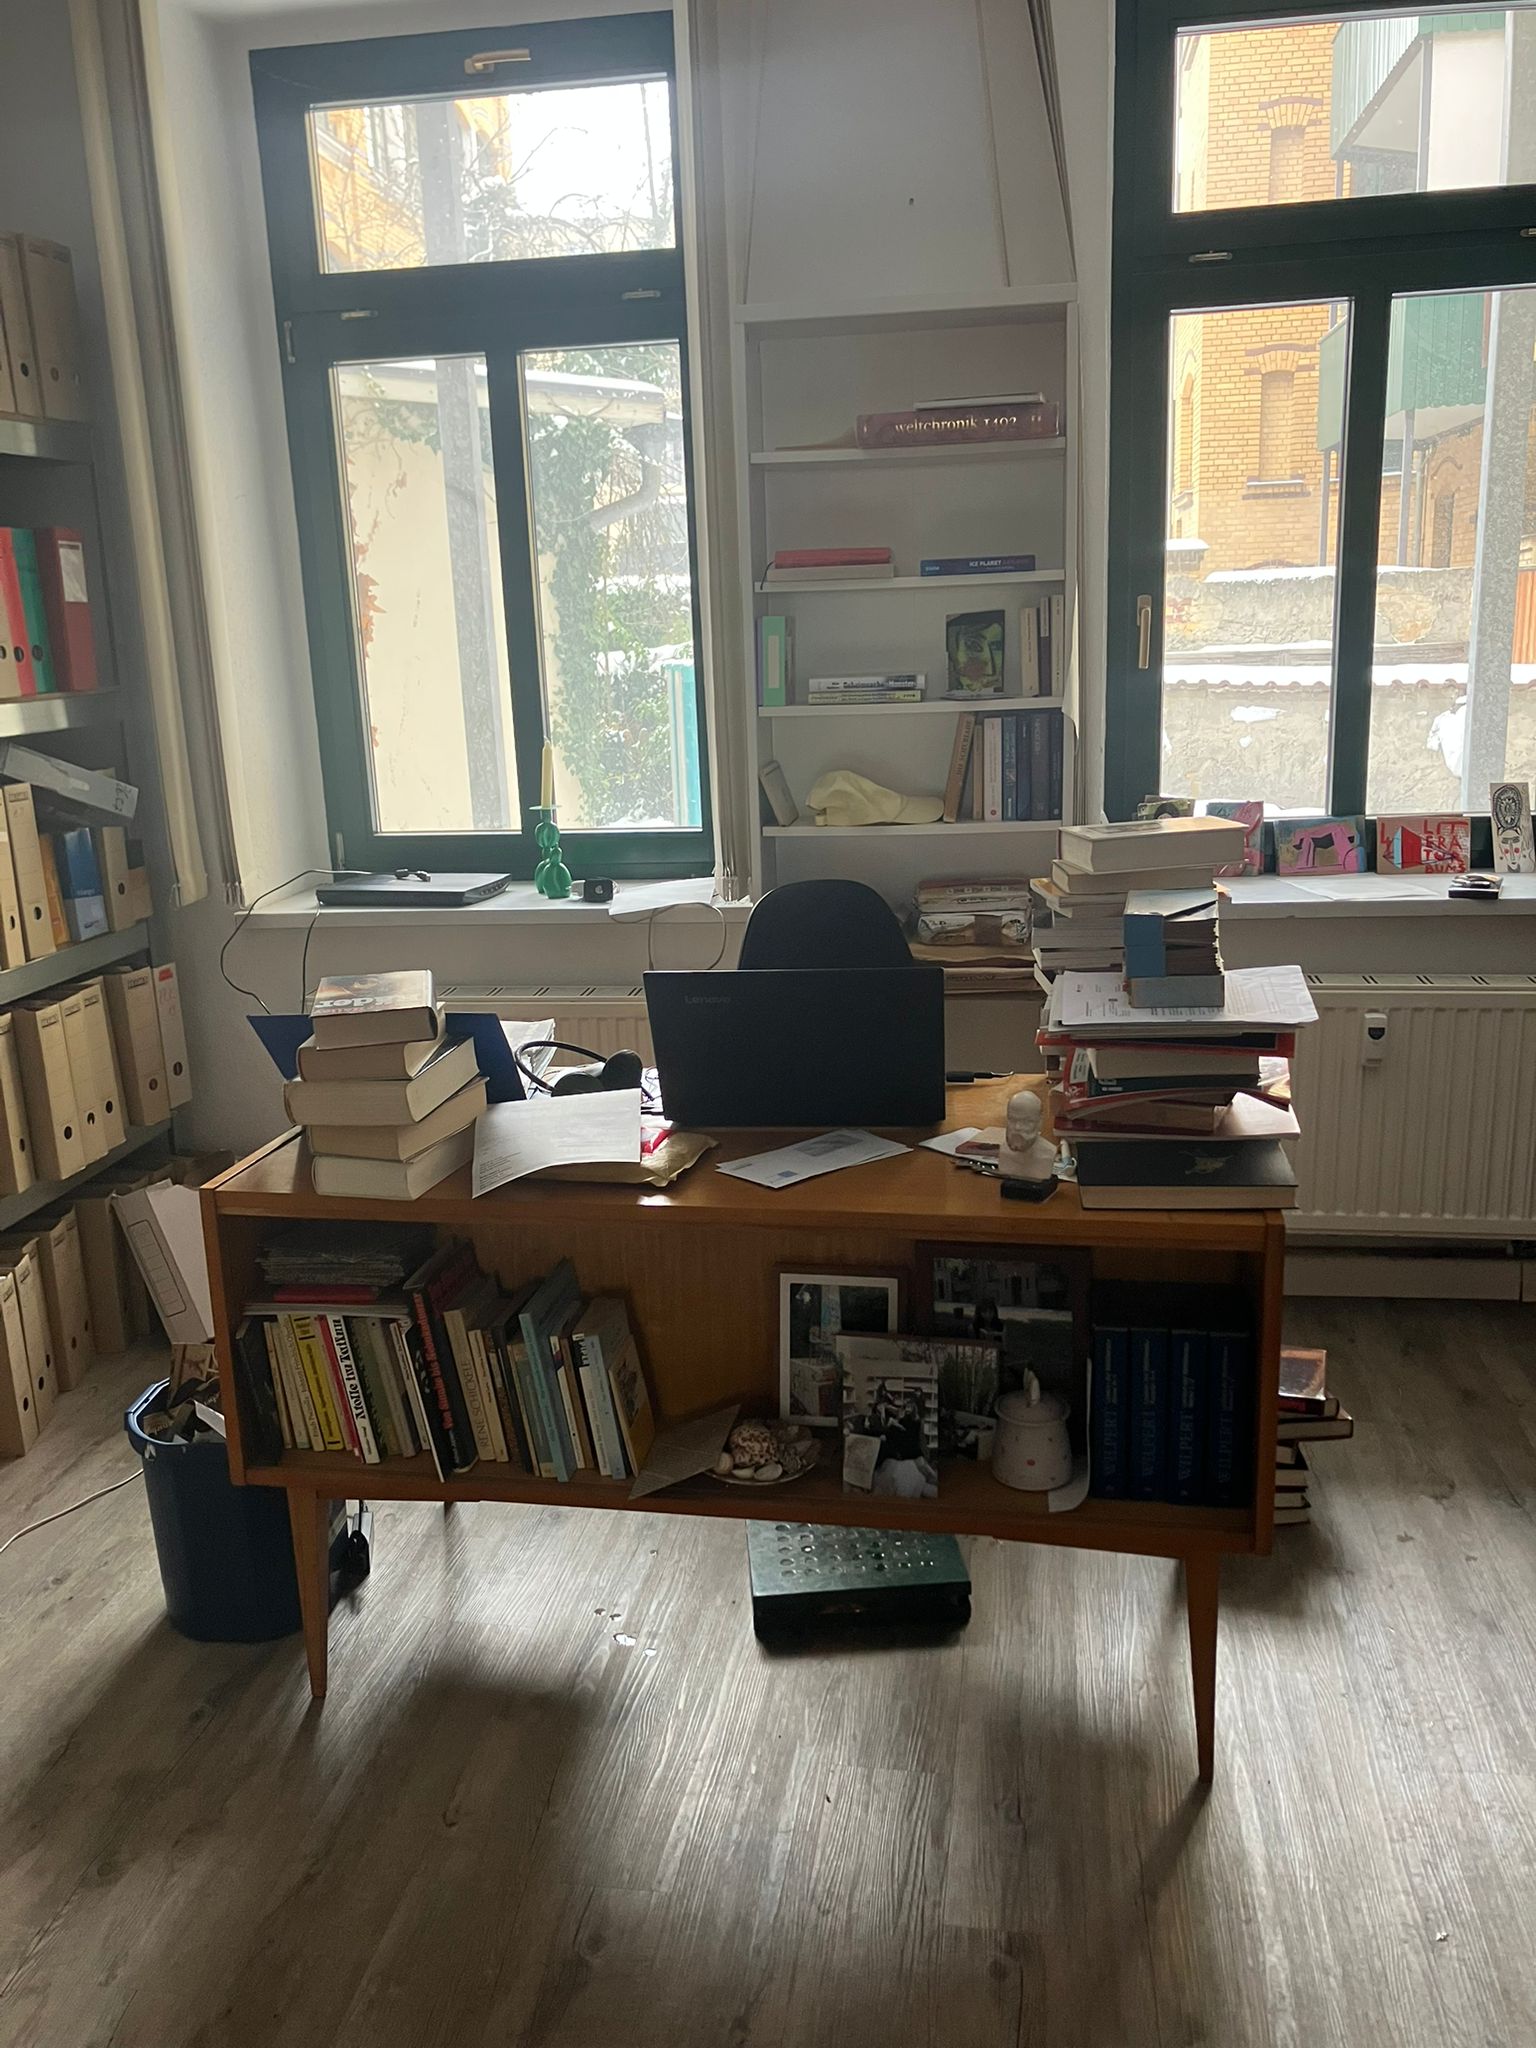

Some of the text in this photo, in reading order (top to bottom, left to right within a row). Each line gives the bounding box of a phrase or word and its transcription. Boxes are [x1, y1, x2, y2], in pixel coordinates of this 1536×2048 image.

[895, 415, 979, 433] weltchronik
[683, 994, 732, 1005] Lenovo
[431, 1361, 441, 1376] bis
[460, 1359, 481, 1417] SCHICKELE
